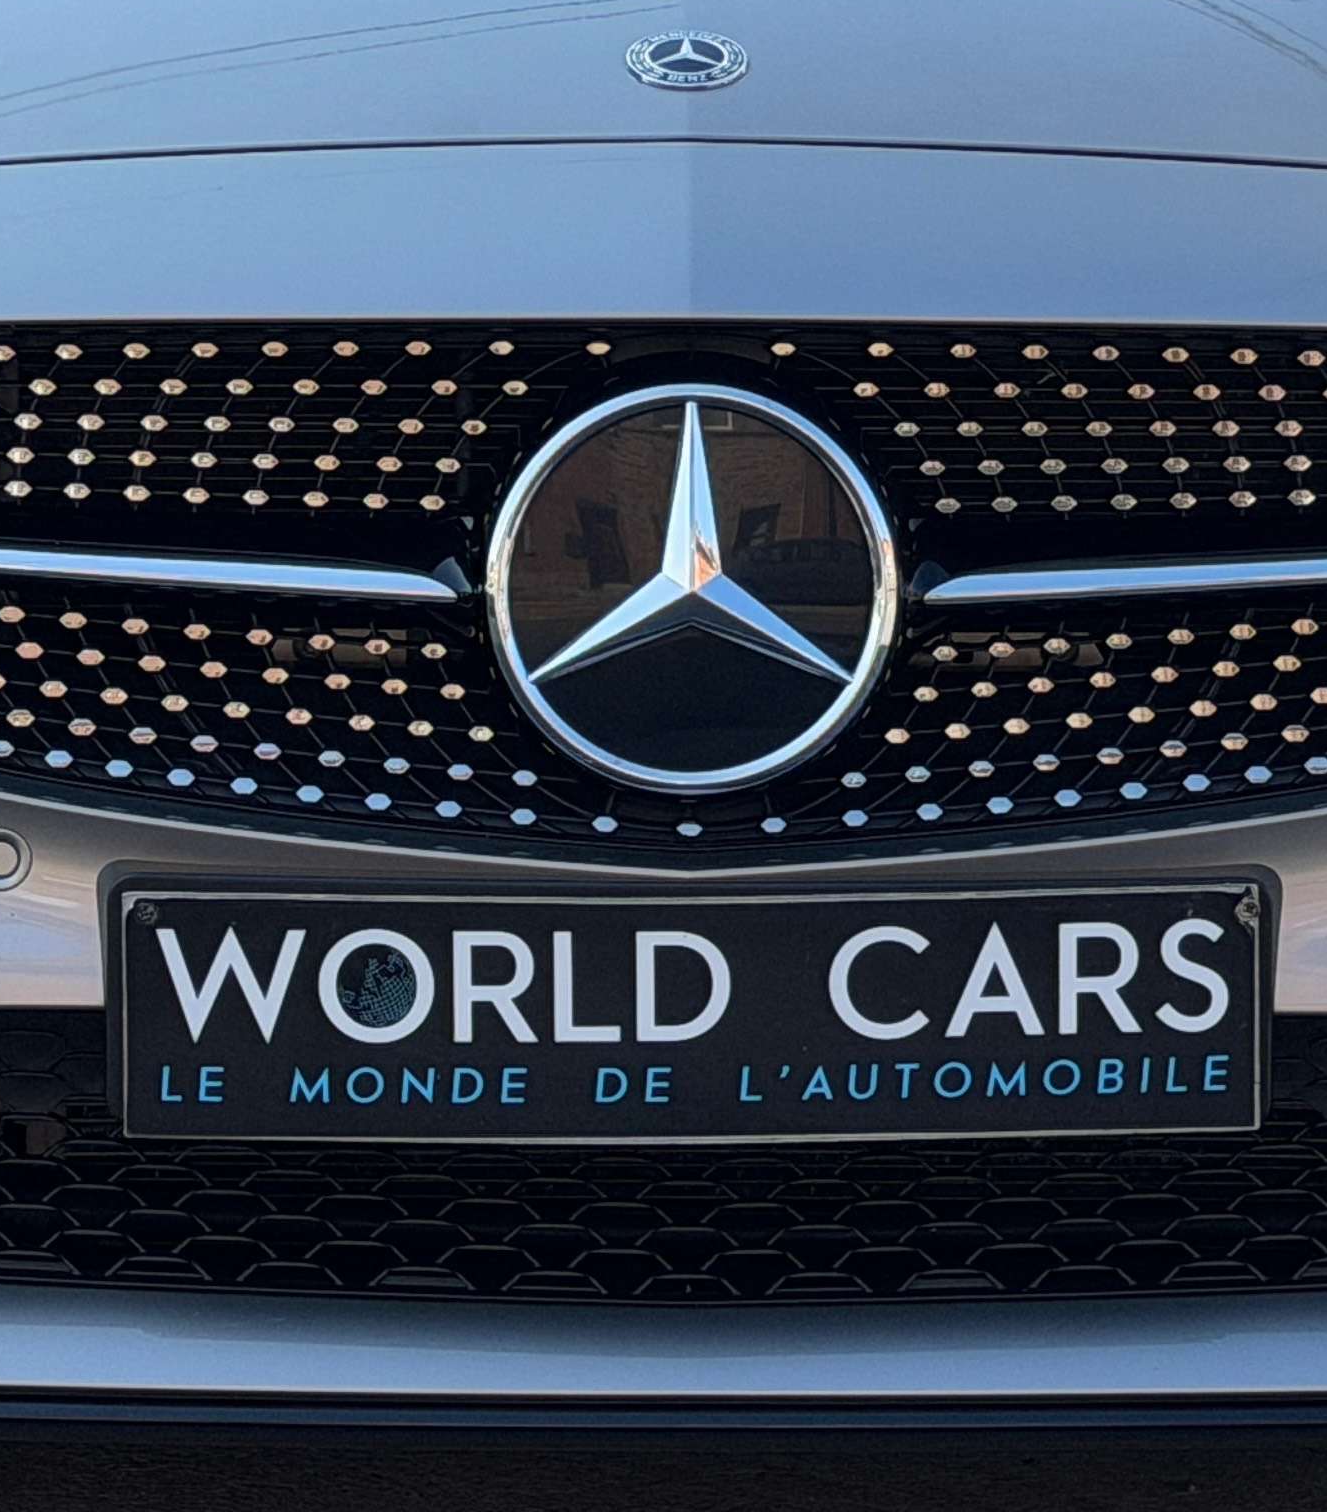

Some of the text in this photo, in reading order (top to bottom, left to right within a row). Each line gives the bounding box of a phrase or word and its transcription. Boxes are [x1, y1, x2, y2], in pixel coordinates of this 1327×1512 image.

[155, 918, 1229, 1044] WORLD CARS
[160, 1054, 1229, 1104] LE MONDE DE L'AUTOMOBILE
